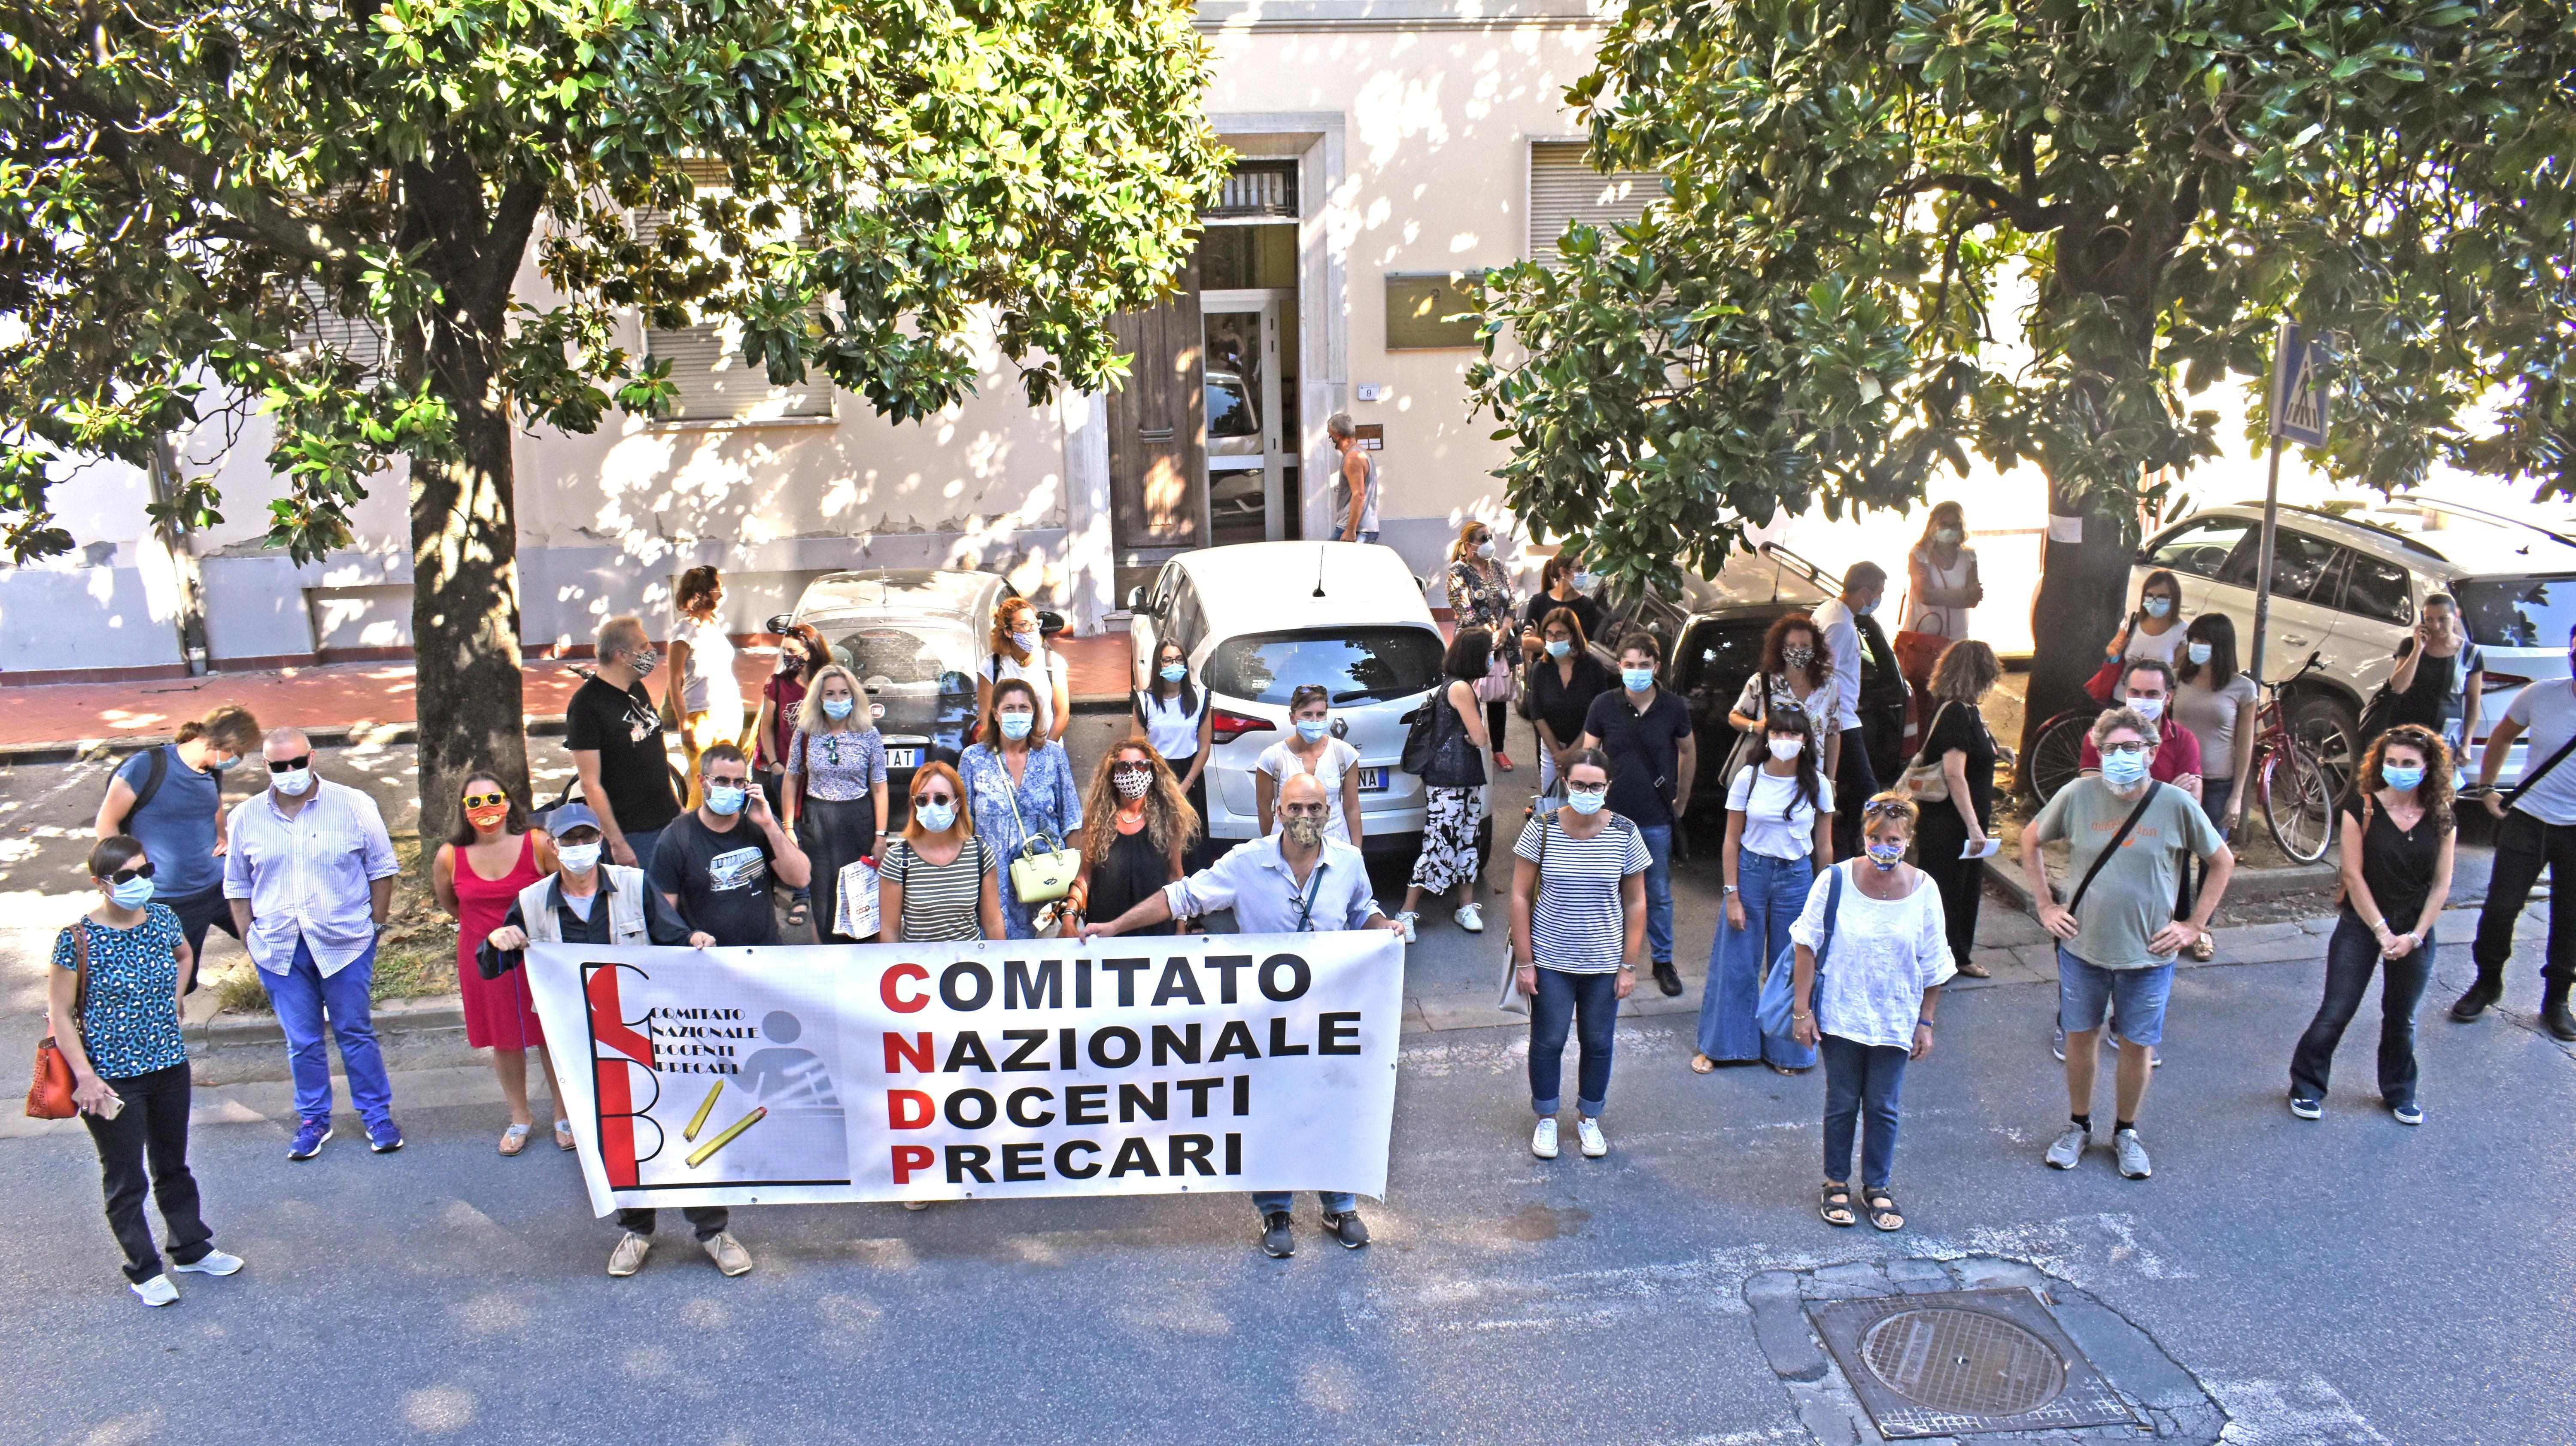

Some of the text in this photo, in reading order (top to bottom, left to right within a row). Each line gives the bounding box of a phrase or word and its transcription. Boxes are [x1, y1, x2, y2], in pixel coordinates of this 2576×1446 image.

[881, 954, 1311, 1012] COMITATO
[650, 1007, 745, 1020] COMITATO
[652, 1026, 759, 1038] NAZIONALE
[883, 1012, 1361, 1073] NAZIONALE
[654, 1044, 735, 1056] DOCENTI
[657, 1061, 738, 1074] PRECARI
[888, 1075, 1249, 1129] DOCENTI
[892, 1133, 1241, 1184] PRECARI
